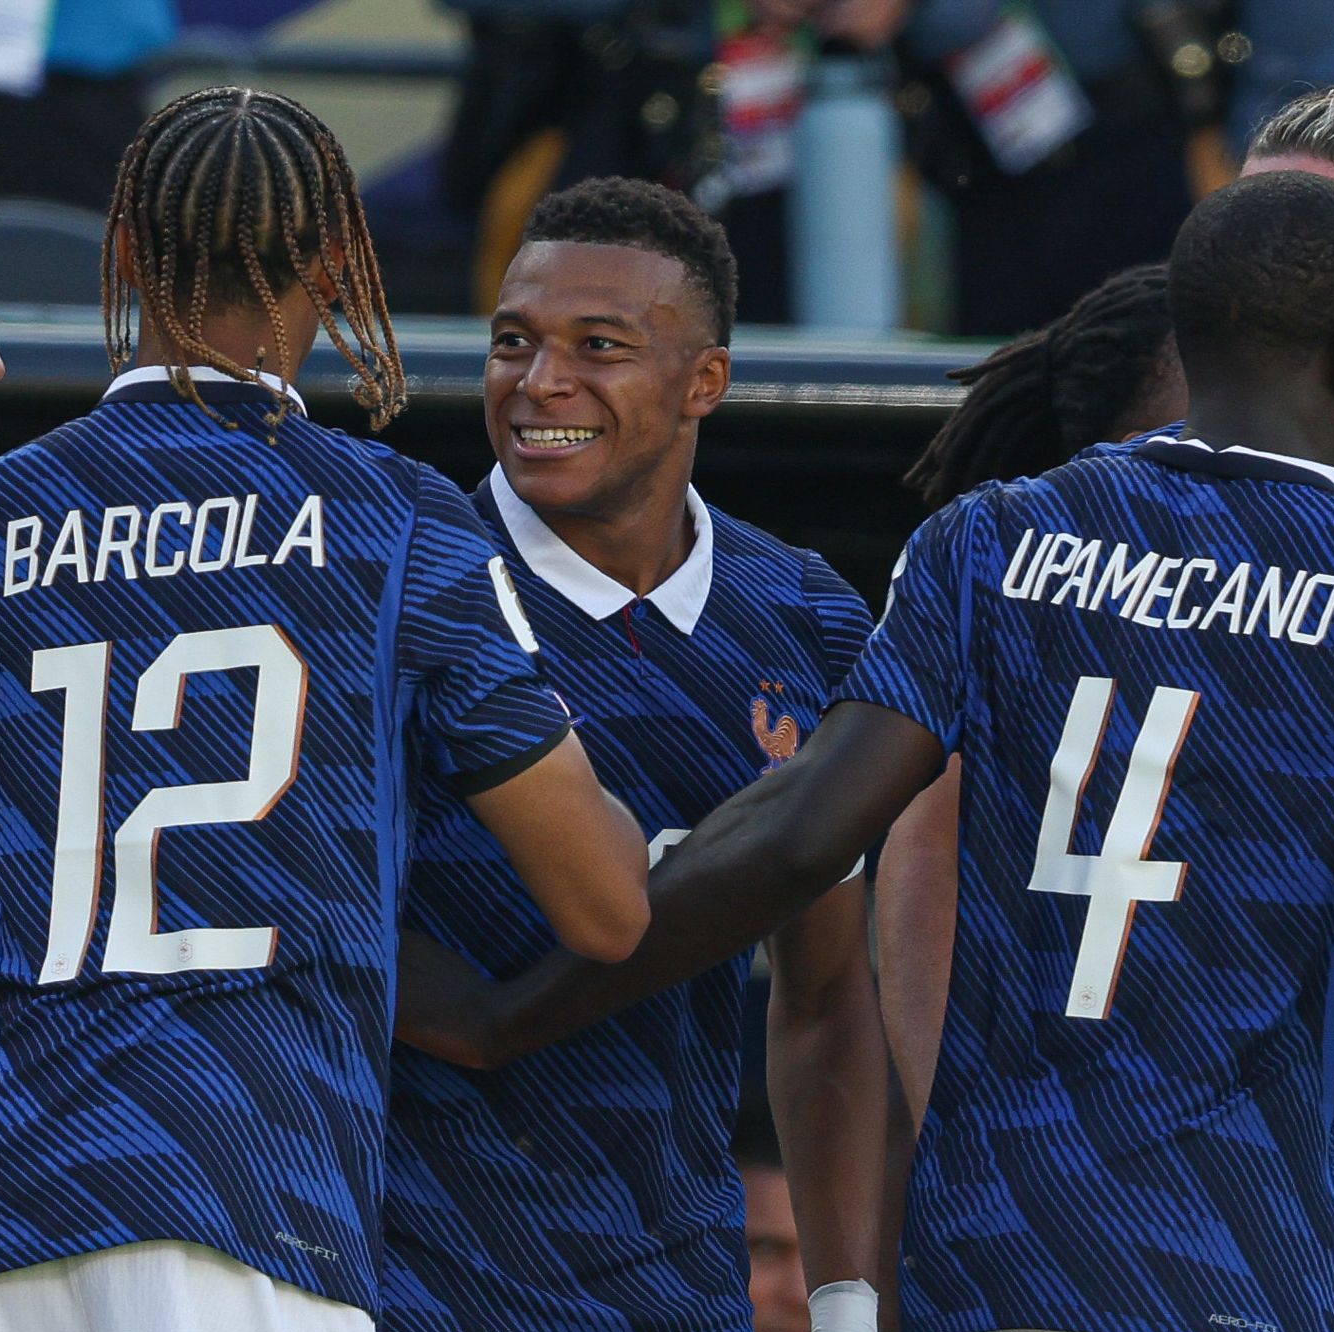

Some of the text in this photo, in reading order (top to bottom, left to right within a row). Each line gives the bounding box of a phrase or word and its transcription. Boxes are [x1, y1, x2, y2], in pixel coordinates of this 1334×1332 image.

[3, 493, 326, 597] BARCOLA
[31, 624, 309, 985] 12
[1027, 676, 1201, 1019] 4
